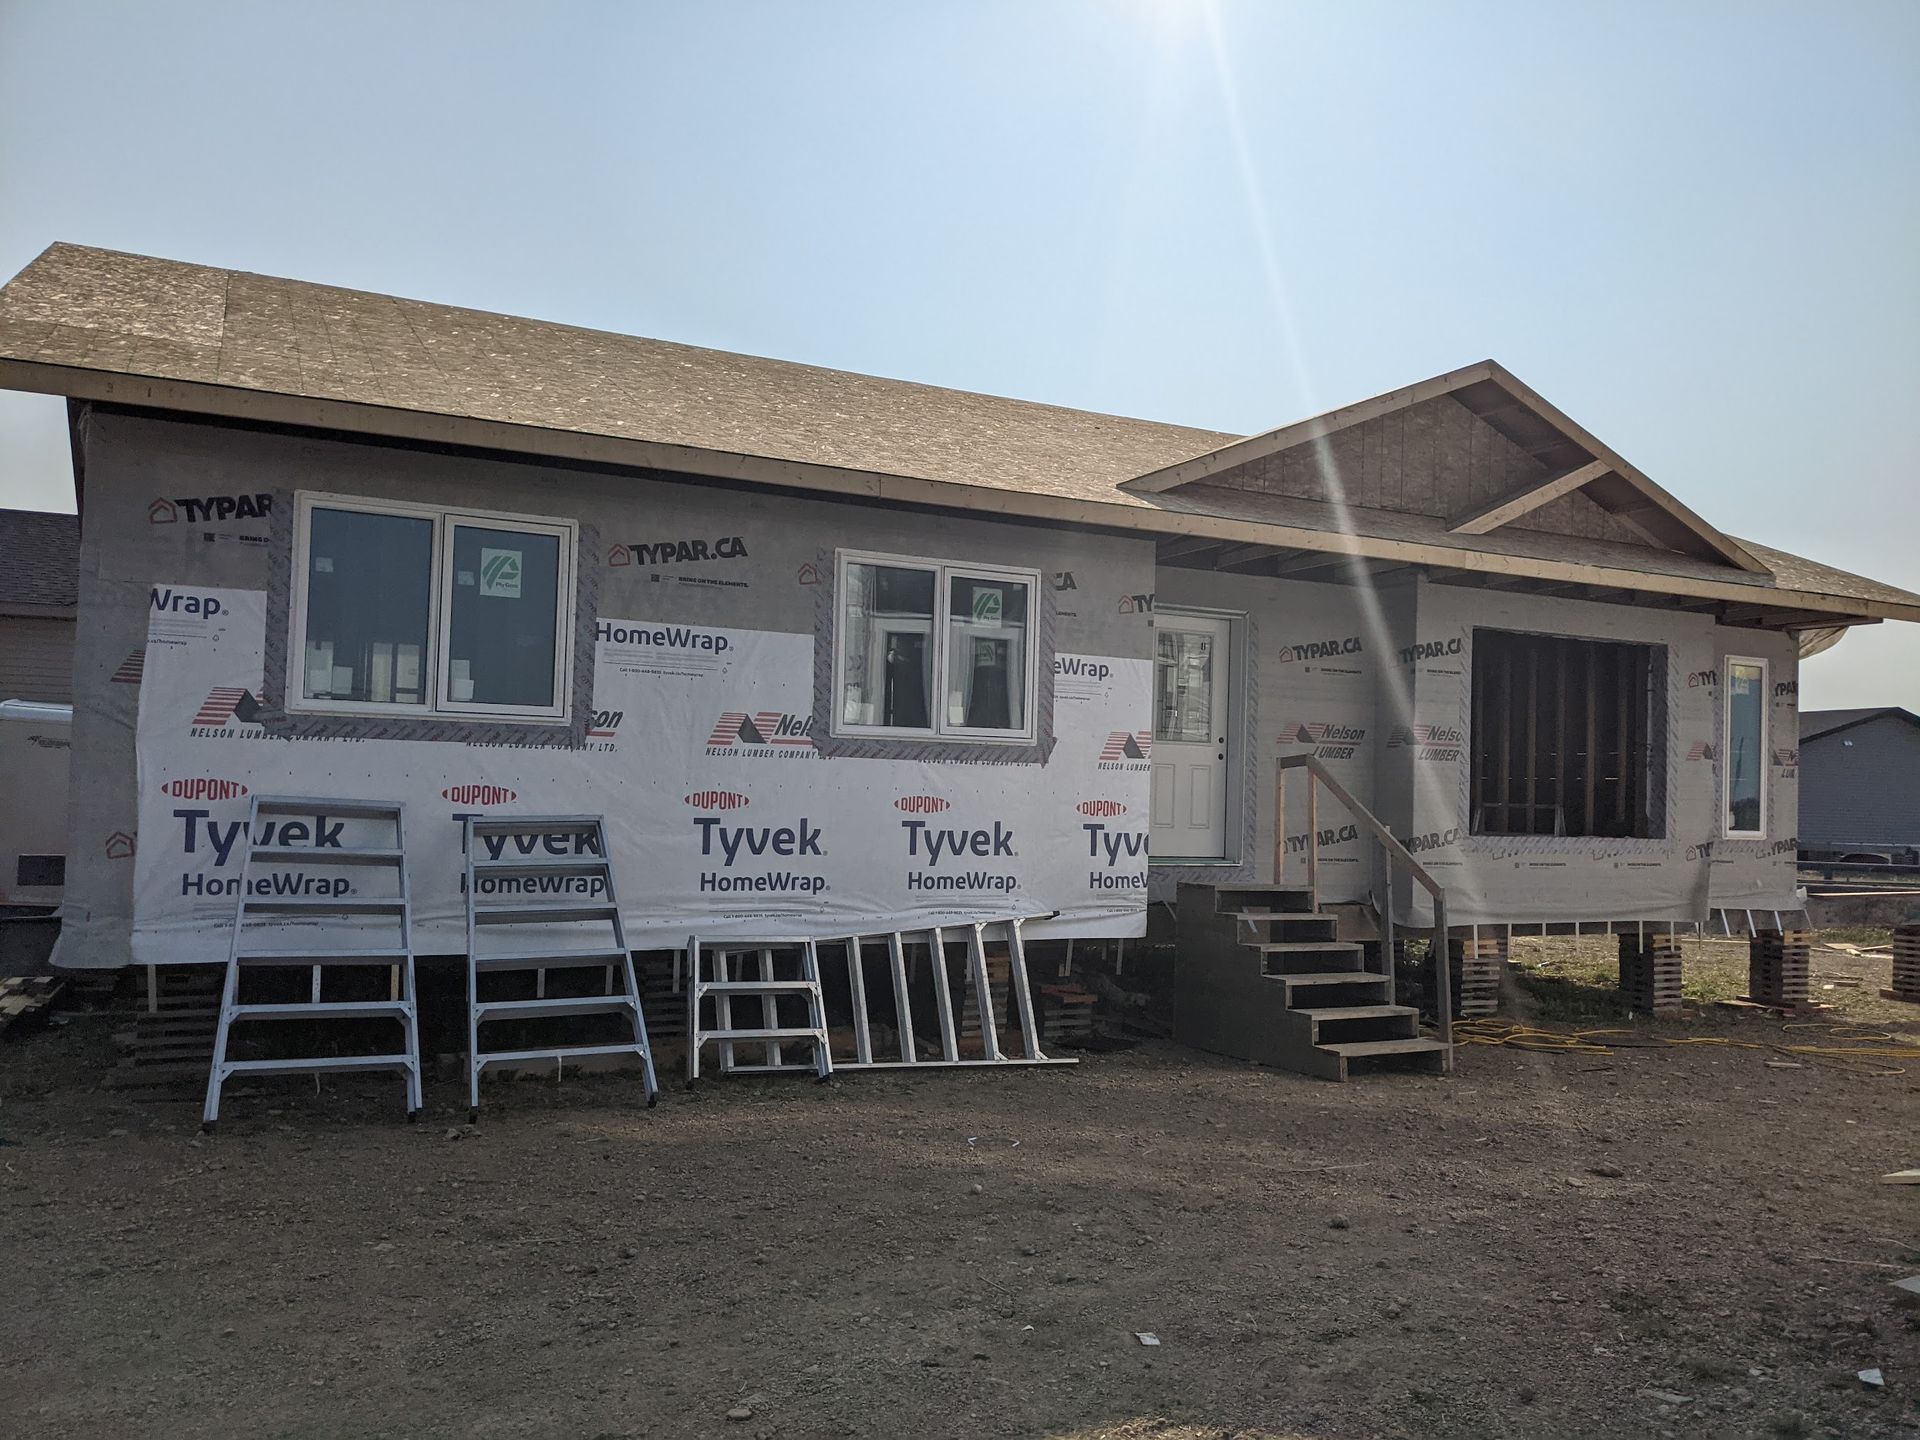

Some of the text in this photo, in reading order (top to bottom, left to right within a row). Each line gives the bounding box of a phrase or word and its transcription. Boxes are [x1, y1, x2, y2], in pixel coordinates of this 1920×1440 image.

[627, 536, 748, 565] TYPAR.CA
[595, 622, 728, 655] HomeWrap
[1291, 636, 1362, 661] TYPAR.CA
[190, 727, 235, 739] NELSON
[774, 714, 813, 737] Nel
[1321, 724, 1365, 741] Nelson
[705, 747, 817, 760] NELSON LUMBER COMPANY
[1418, 748, 1460, 762] LUMBER
[1097, 762, 1124, 771] NELSON
[172, 778, 239, 801] DUPONT
[451, 784, 509, 806] DUPONT
[692, 791, 743, 810] DUPONT
[901, 796, 945, 813] DUPONT
[1082, 800, 1122, 817] DUPONT
[173, 809, 345, 866] Tyvek
[693, 818, 822, 866] Tyvek
[902, 820, 1013, 867] Tyvek
[1083, 823, 1149, 867] Tyv
[1287, 824, 1359, 853] TYAR.CA
[182, 873, 349, 898] HomeWrap
[700, 872, 825, 895] HomeWrap
[908, 871, 1017, 894] HomeWrap
